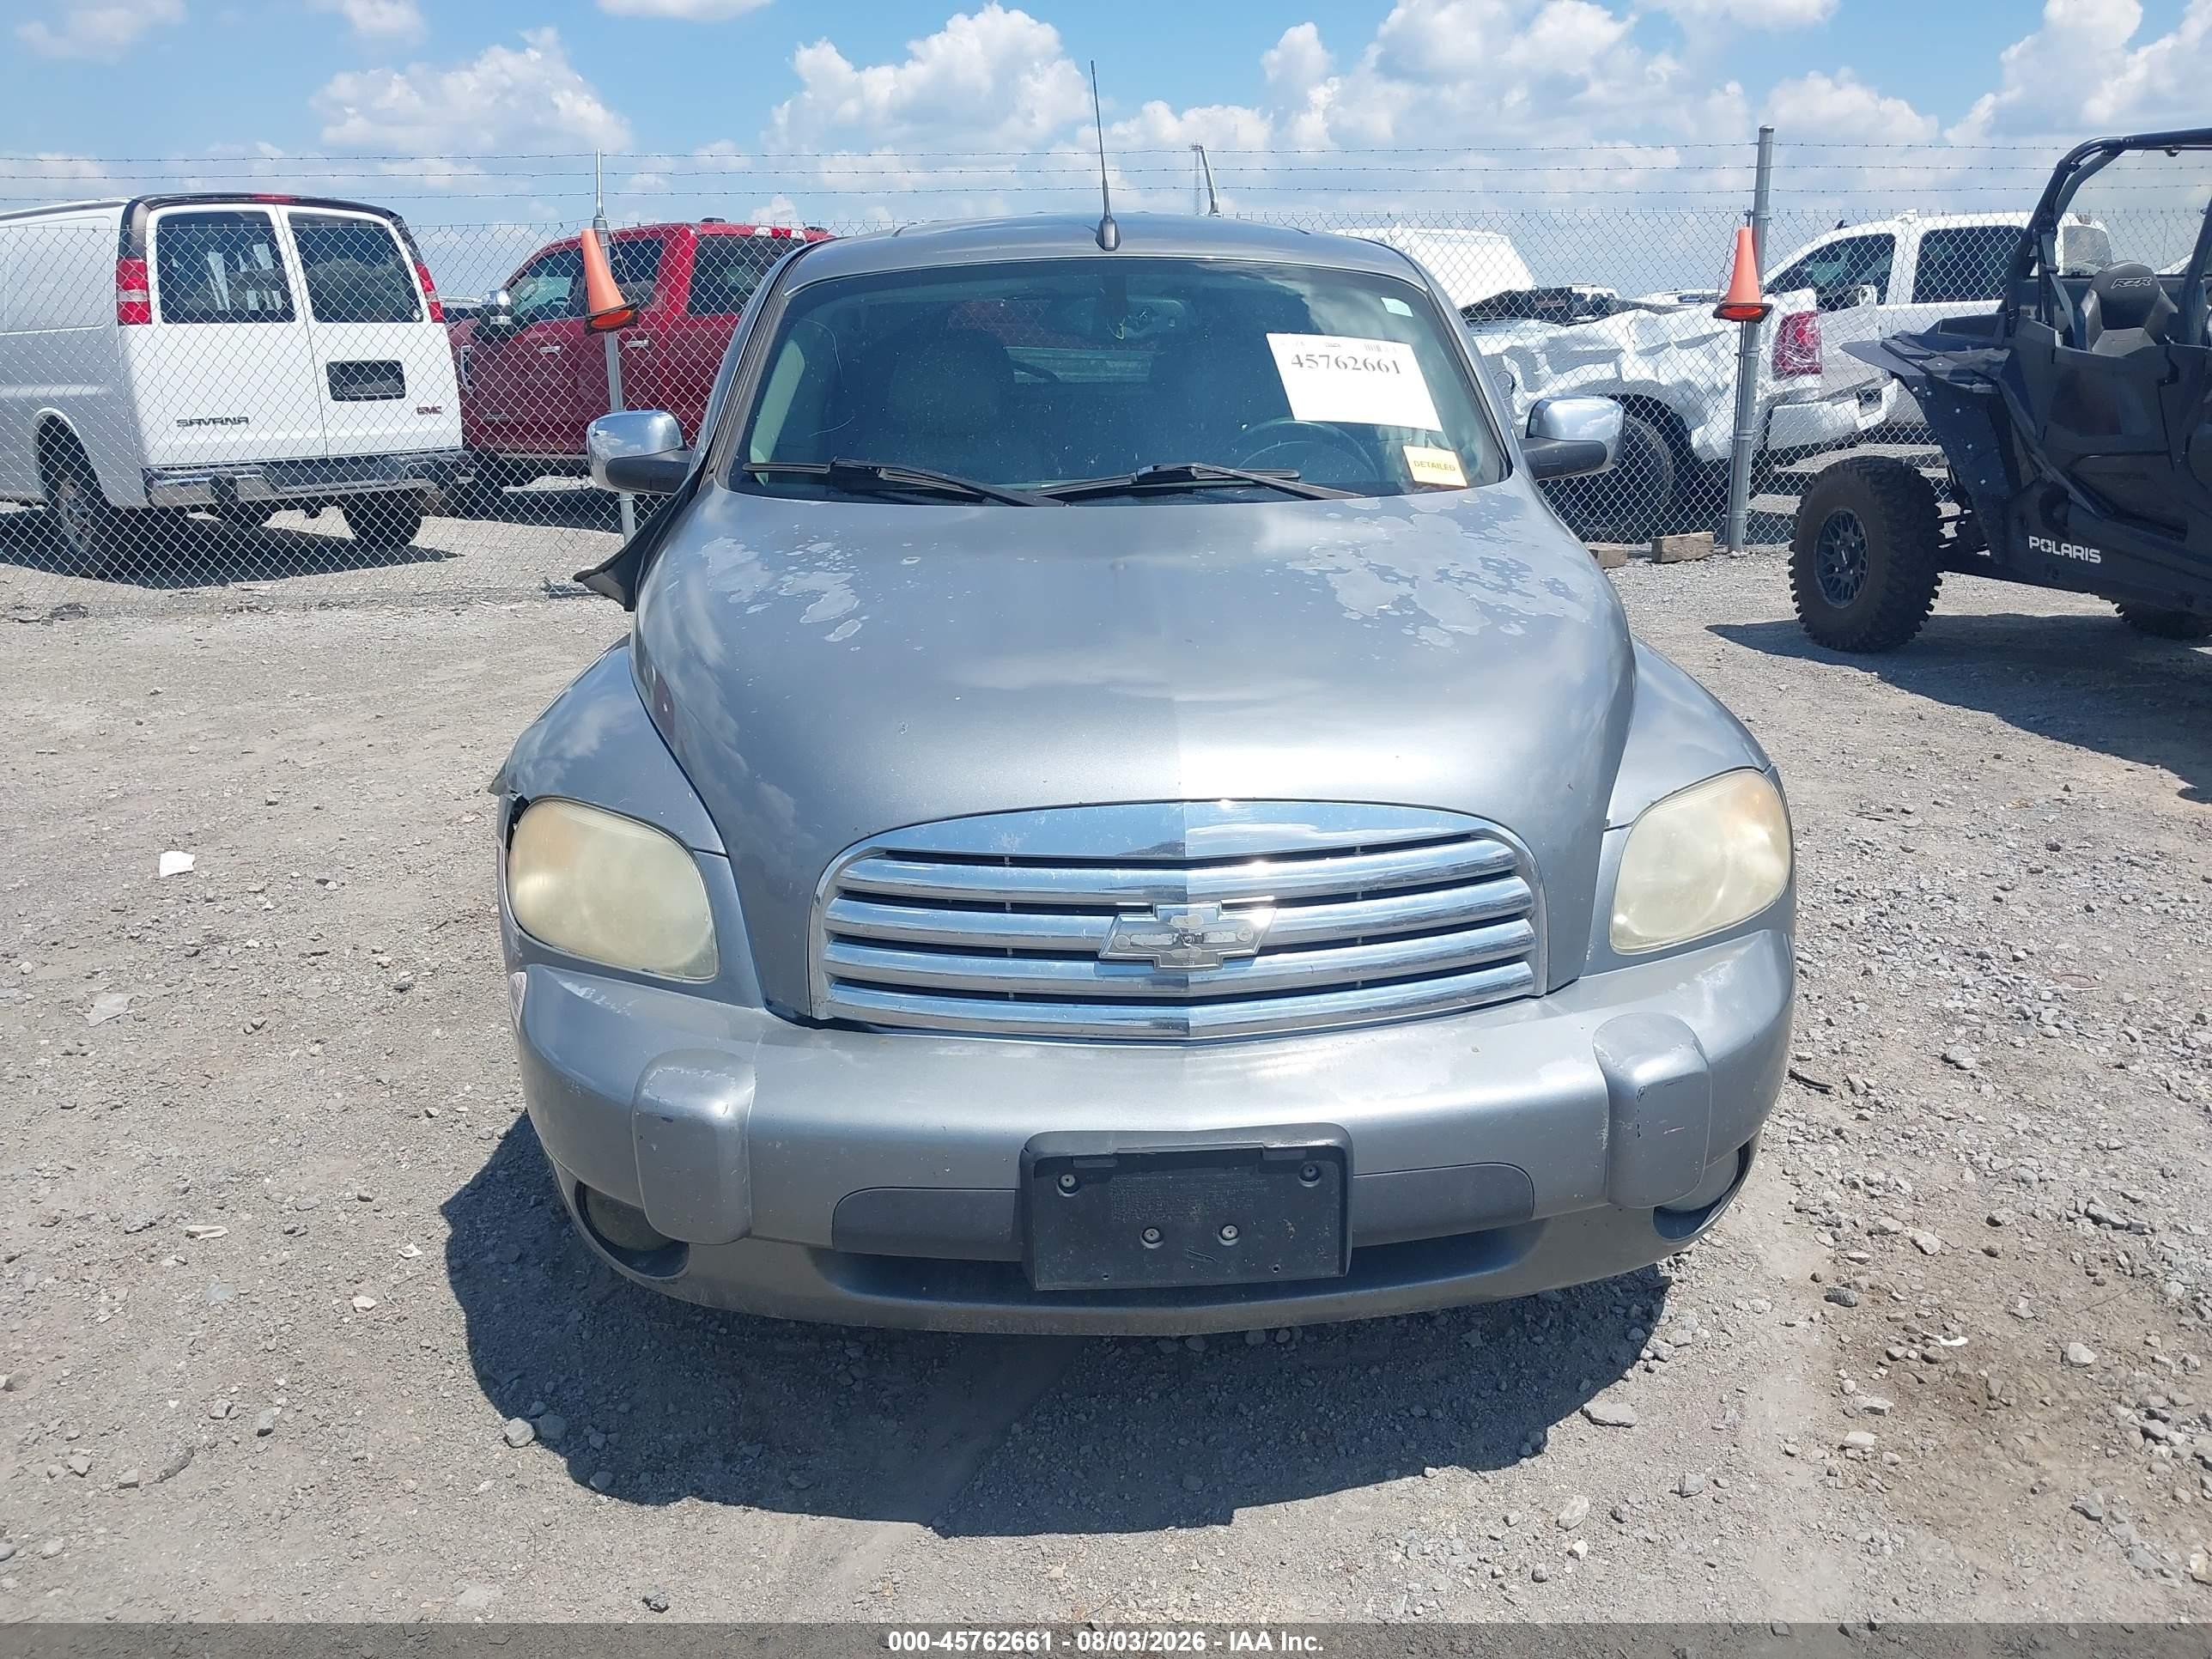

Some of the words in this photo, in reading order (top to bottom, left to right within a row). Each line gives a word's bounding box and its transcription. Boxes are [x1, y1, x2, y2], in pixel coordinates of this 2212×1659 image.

[2111, 277, 2152, 289] RZR
[1291, 354, 1401, 374] 45762661
[416, 406, 442, 415] GMC
[177, 416, 249, 427] SAVANA
[1413, 460, 1455, 471] DETAILED
[2028, 535, 2101, 564] POLARIS
